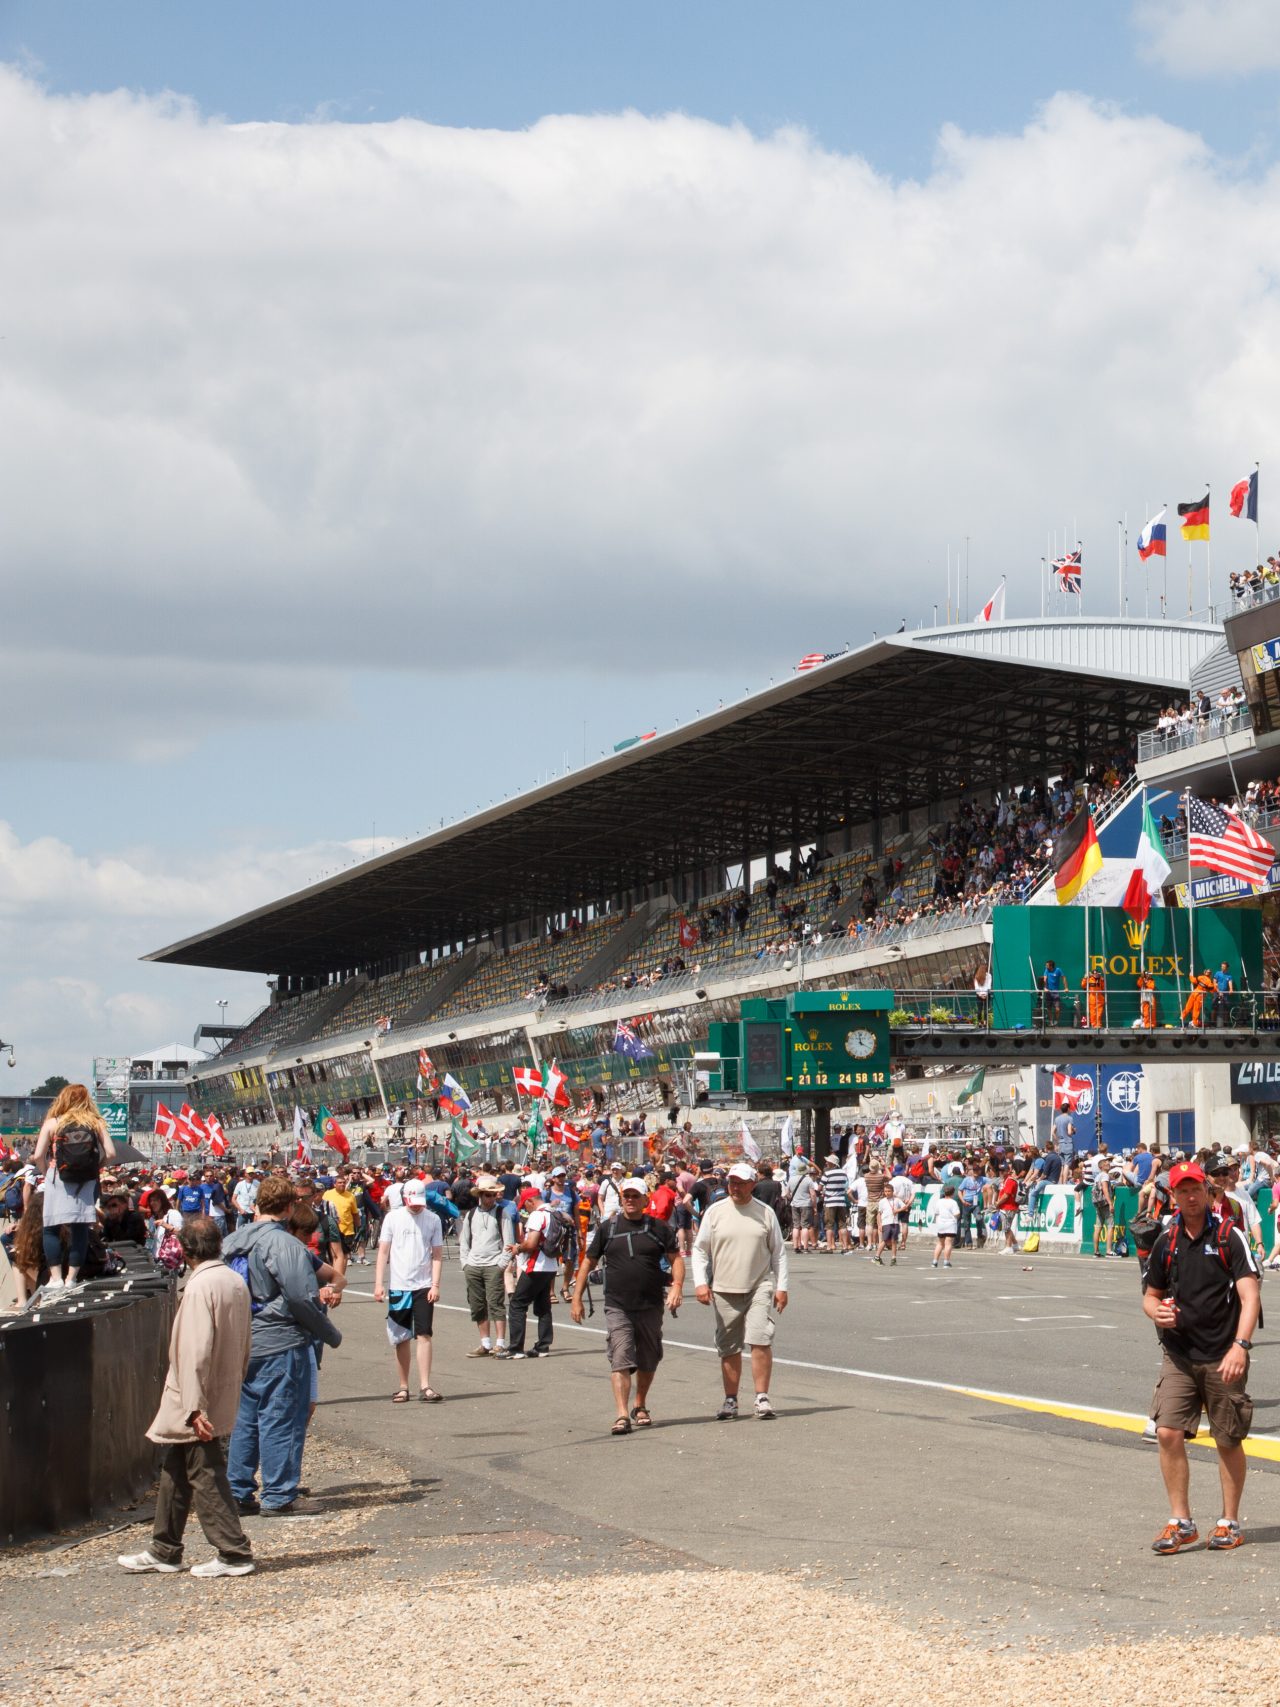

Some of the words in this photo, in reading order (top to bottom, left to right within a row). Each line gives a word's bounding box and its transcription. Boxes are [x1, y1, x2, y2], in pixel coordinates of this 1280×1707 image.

[1088, 955, 1184, 976] ROLEX
[829, 1003, 861, 1011] ROLEX
[794, 1042, 832, 1051] ROLEX
[816, 1074, 828, 1084] 12
[839, 1073, 851, 1083] 24
[872, 1072, 884, 1083] 12
